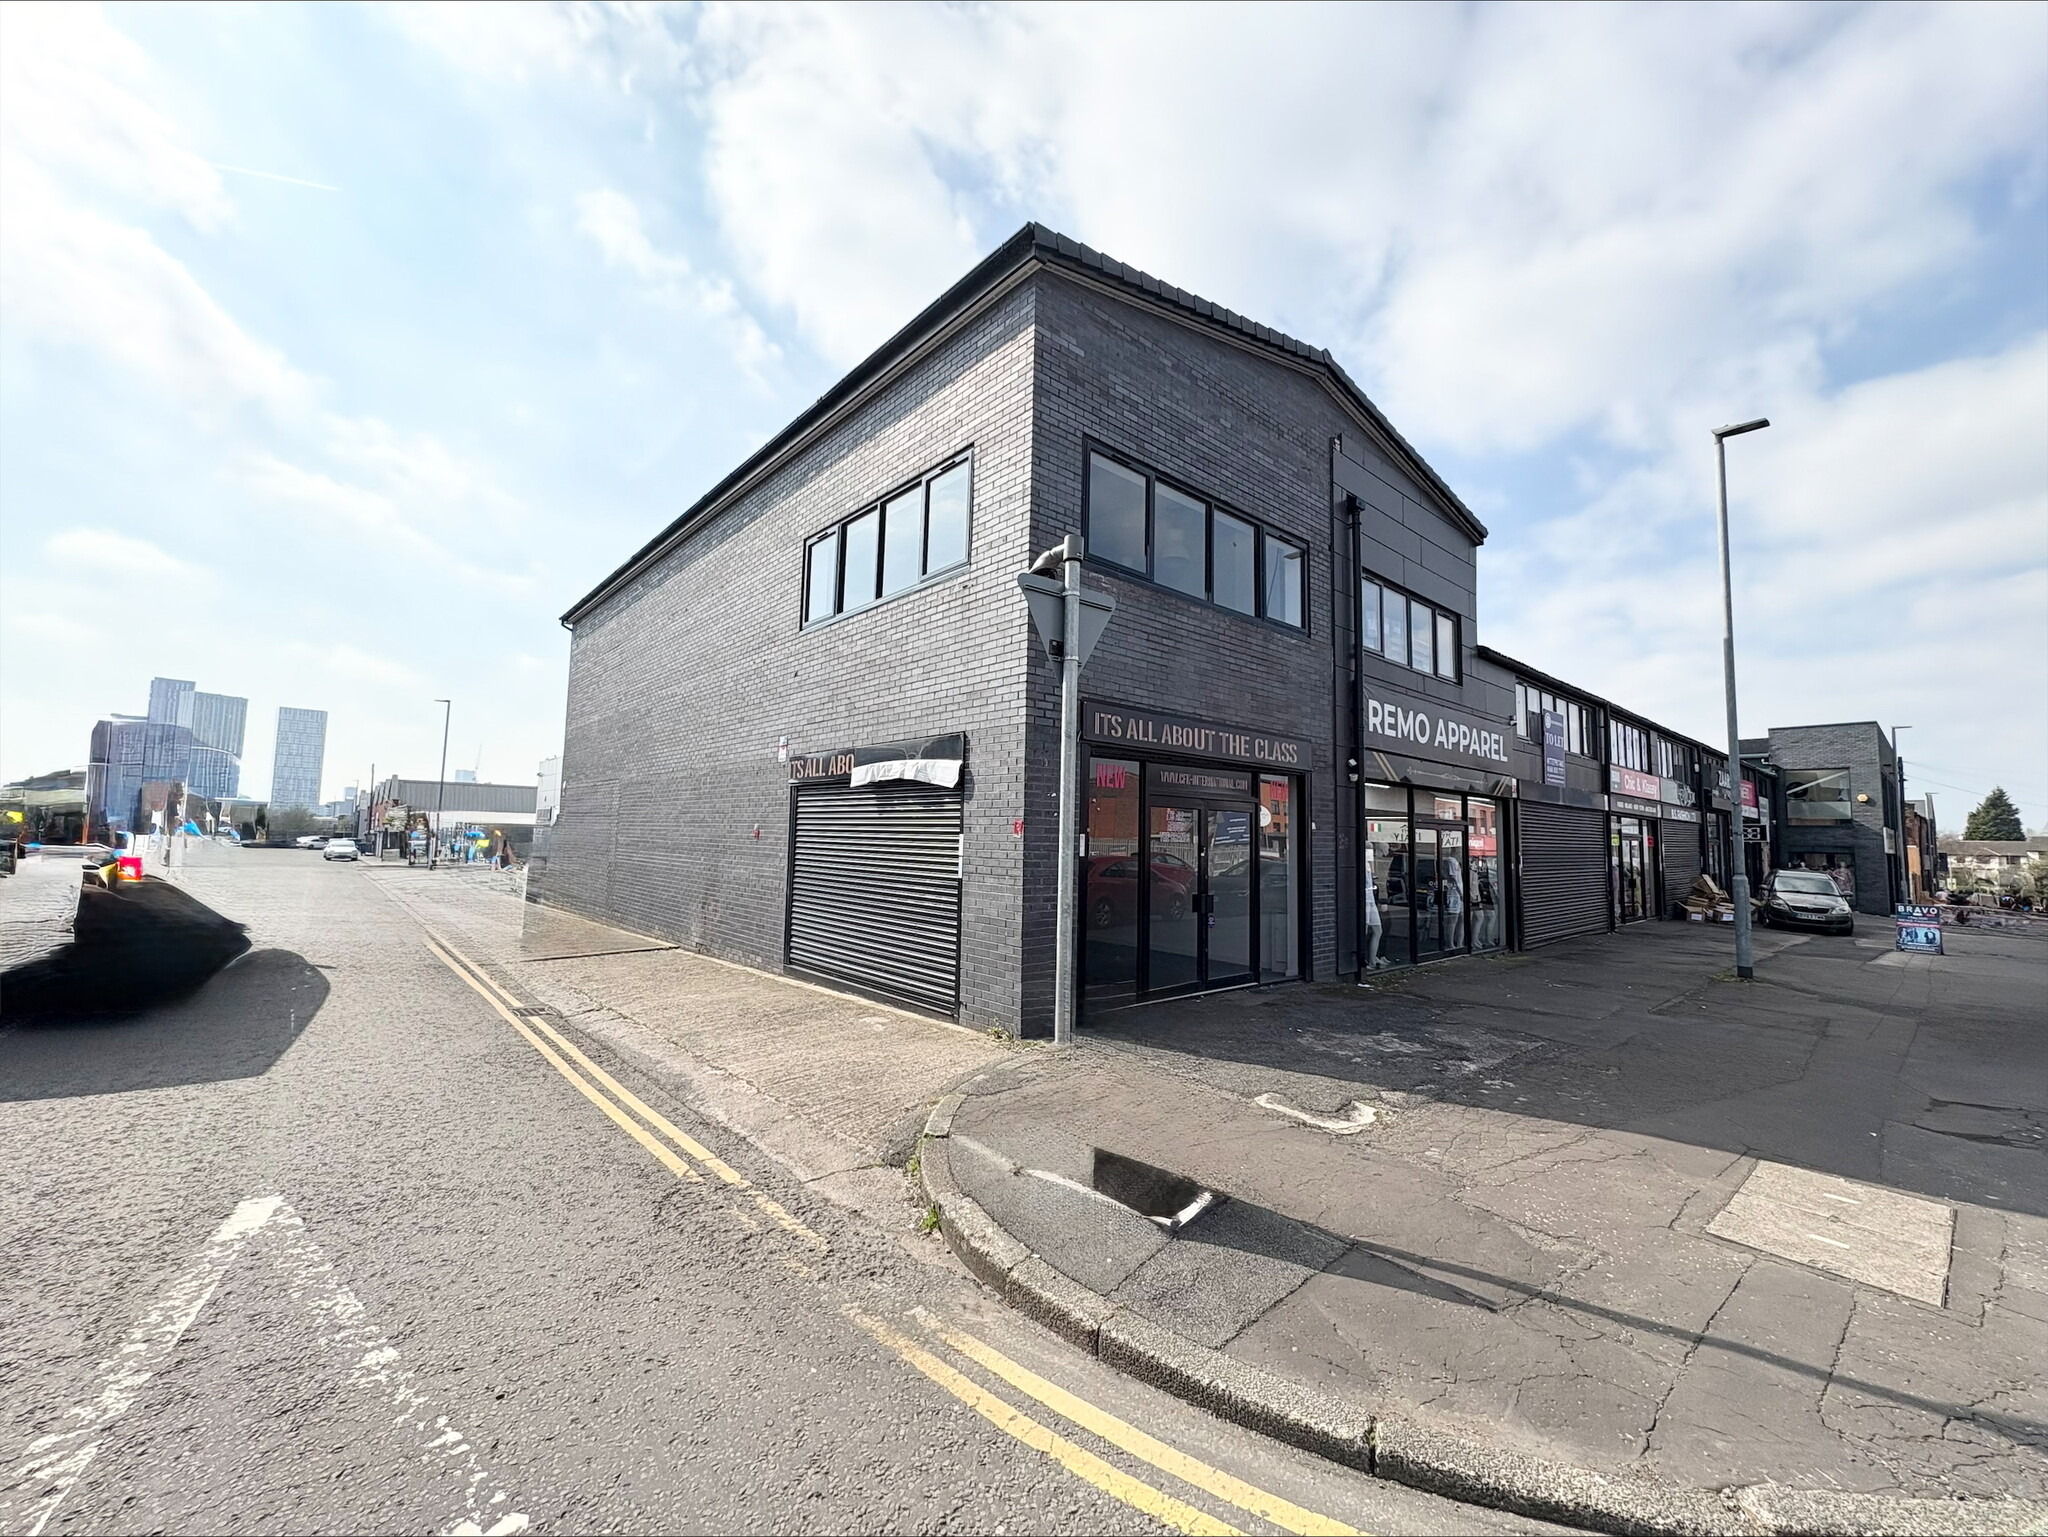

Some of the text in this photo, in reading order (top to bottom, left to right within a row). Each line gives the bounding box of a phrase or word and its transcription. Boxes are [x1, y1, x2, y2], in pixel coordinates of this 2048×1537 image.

[1094, 712, 1298, 764] ITS ALL ABOUT THE CLASS
[1368, 699, 1509, 763] REMO APPAREL
[1545, 732, 1564, 748] TO LET
[805, 757, 826, 778] ALL
[1096, 763, 1126, 789] NEW
[1898, 905, 1938, 915] BRAVO
